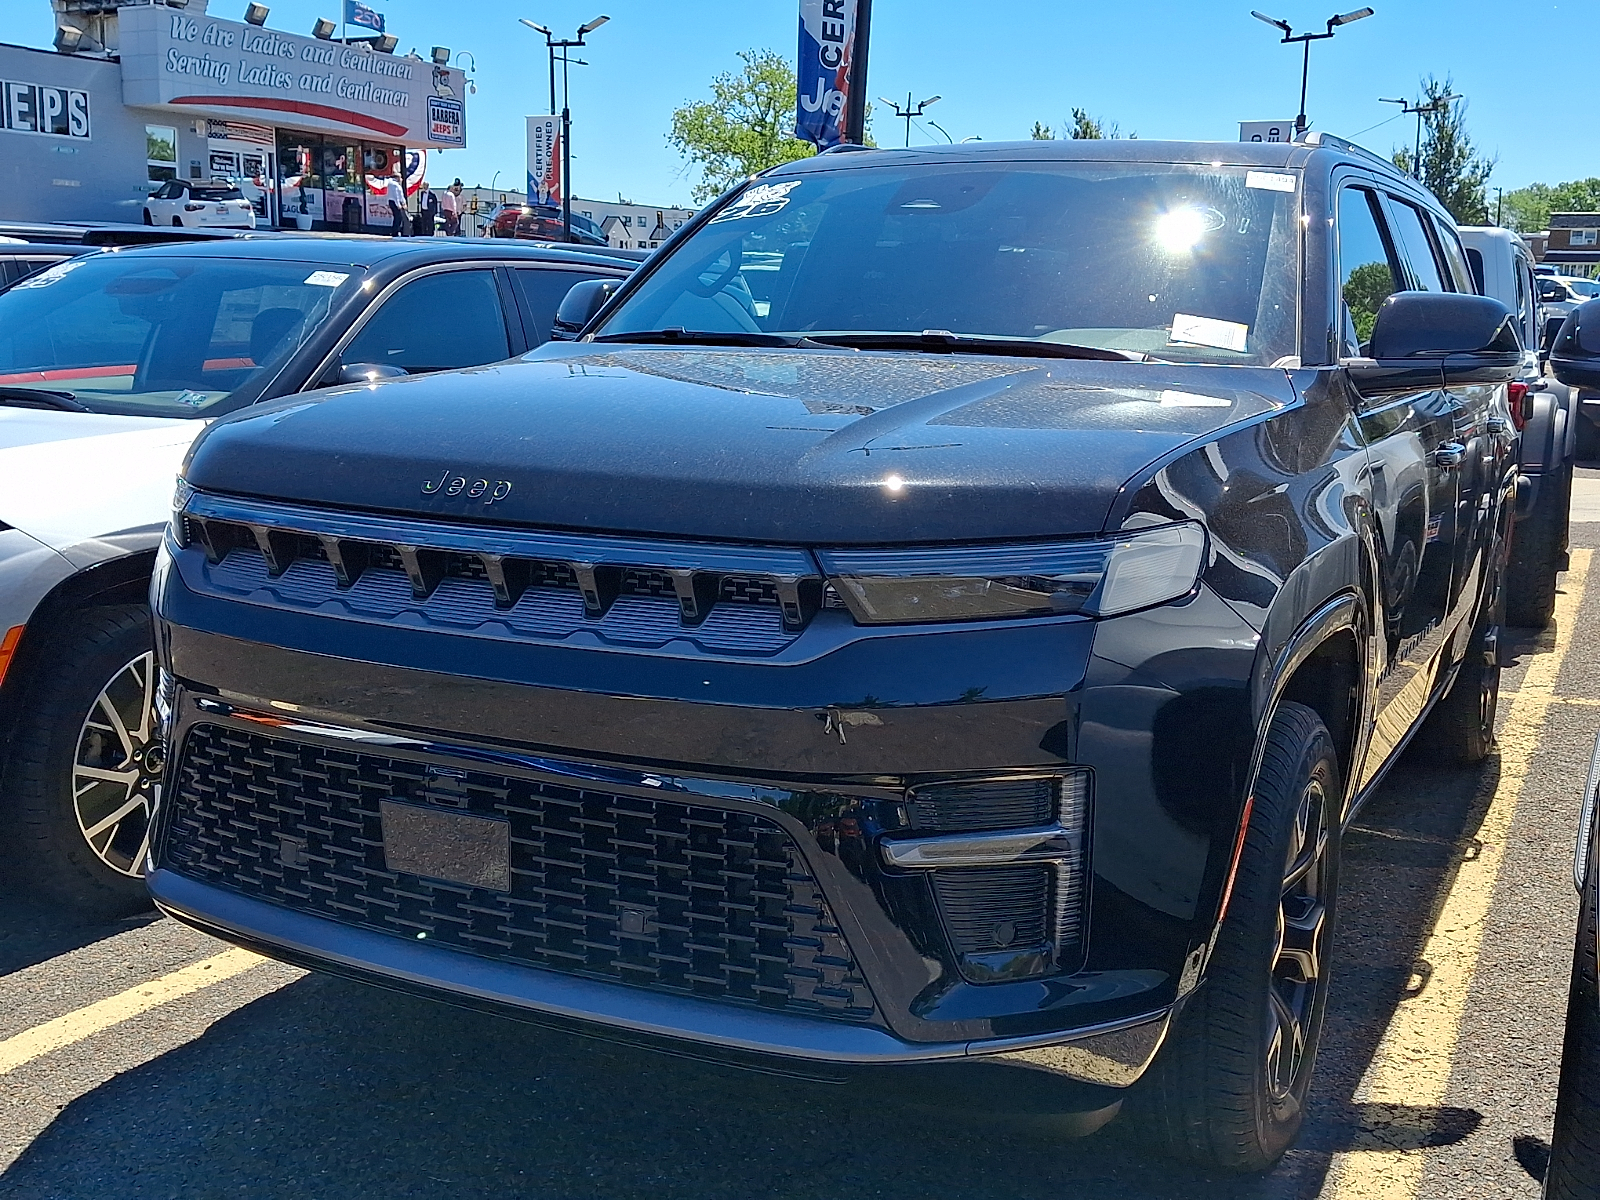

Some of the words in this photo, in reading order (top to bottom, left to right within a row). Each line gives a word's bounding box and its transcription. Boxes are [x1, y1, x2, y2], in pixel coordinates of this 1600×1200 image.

[354, 9, 381, 28] 250
[171, 15, 198, 42] We
[202, 22, 235, 48] Are
[242, 28, 295, 59] Ladies
[301, 45, 337, 66] and
[341, 48, 413, 80] Gentlemen
[166, 47, 231, 85] Serving
[238, 60, 292, 89] Ladies
[299, 73, 334, 93] and
[336, 76, 409, 108] Gentlemen
[432, 107, 460, 126] BARBERA
[432, 123, 451, 134] JEEPS
[535, 126, 543, 178] CERTIFIED
[421, 469, 512, 505] Jeep
